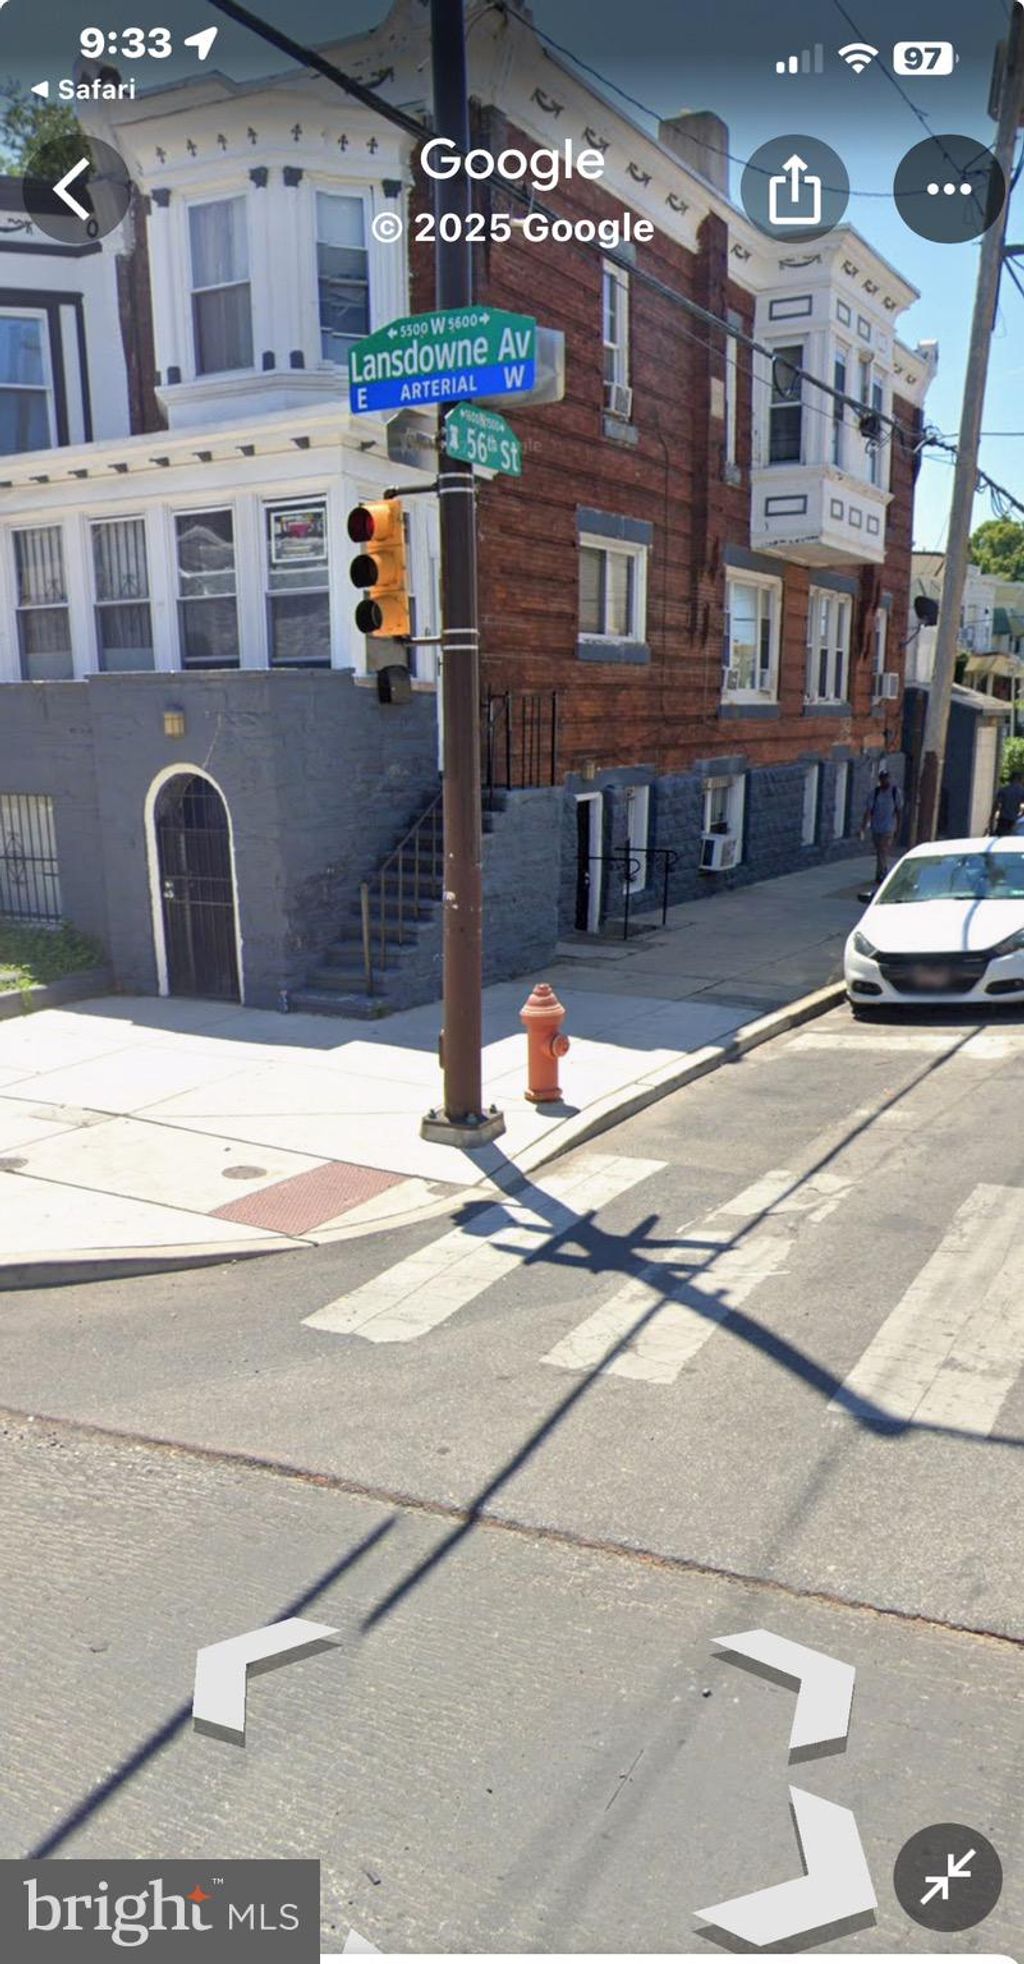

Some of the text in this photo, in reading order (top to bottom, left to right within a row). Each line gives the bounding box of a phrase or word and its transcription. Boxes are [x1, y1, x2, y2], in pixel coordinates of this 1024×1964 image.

[400, 313, 478, 338] 5500 W 5600
[351, 326, 532, 383] Lansdowne Av
[357, 364, 526, 409] E ARTERIAL W
[466, 426, 498, 463] 56th
[500, 439, 519, 473] St
